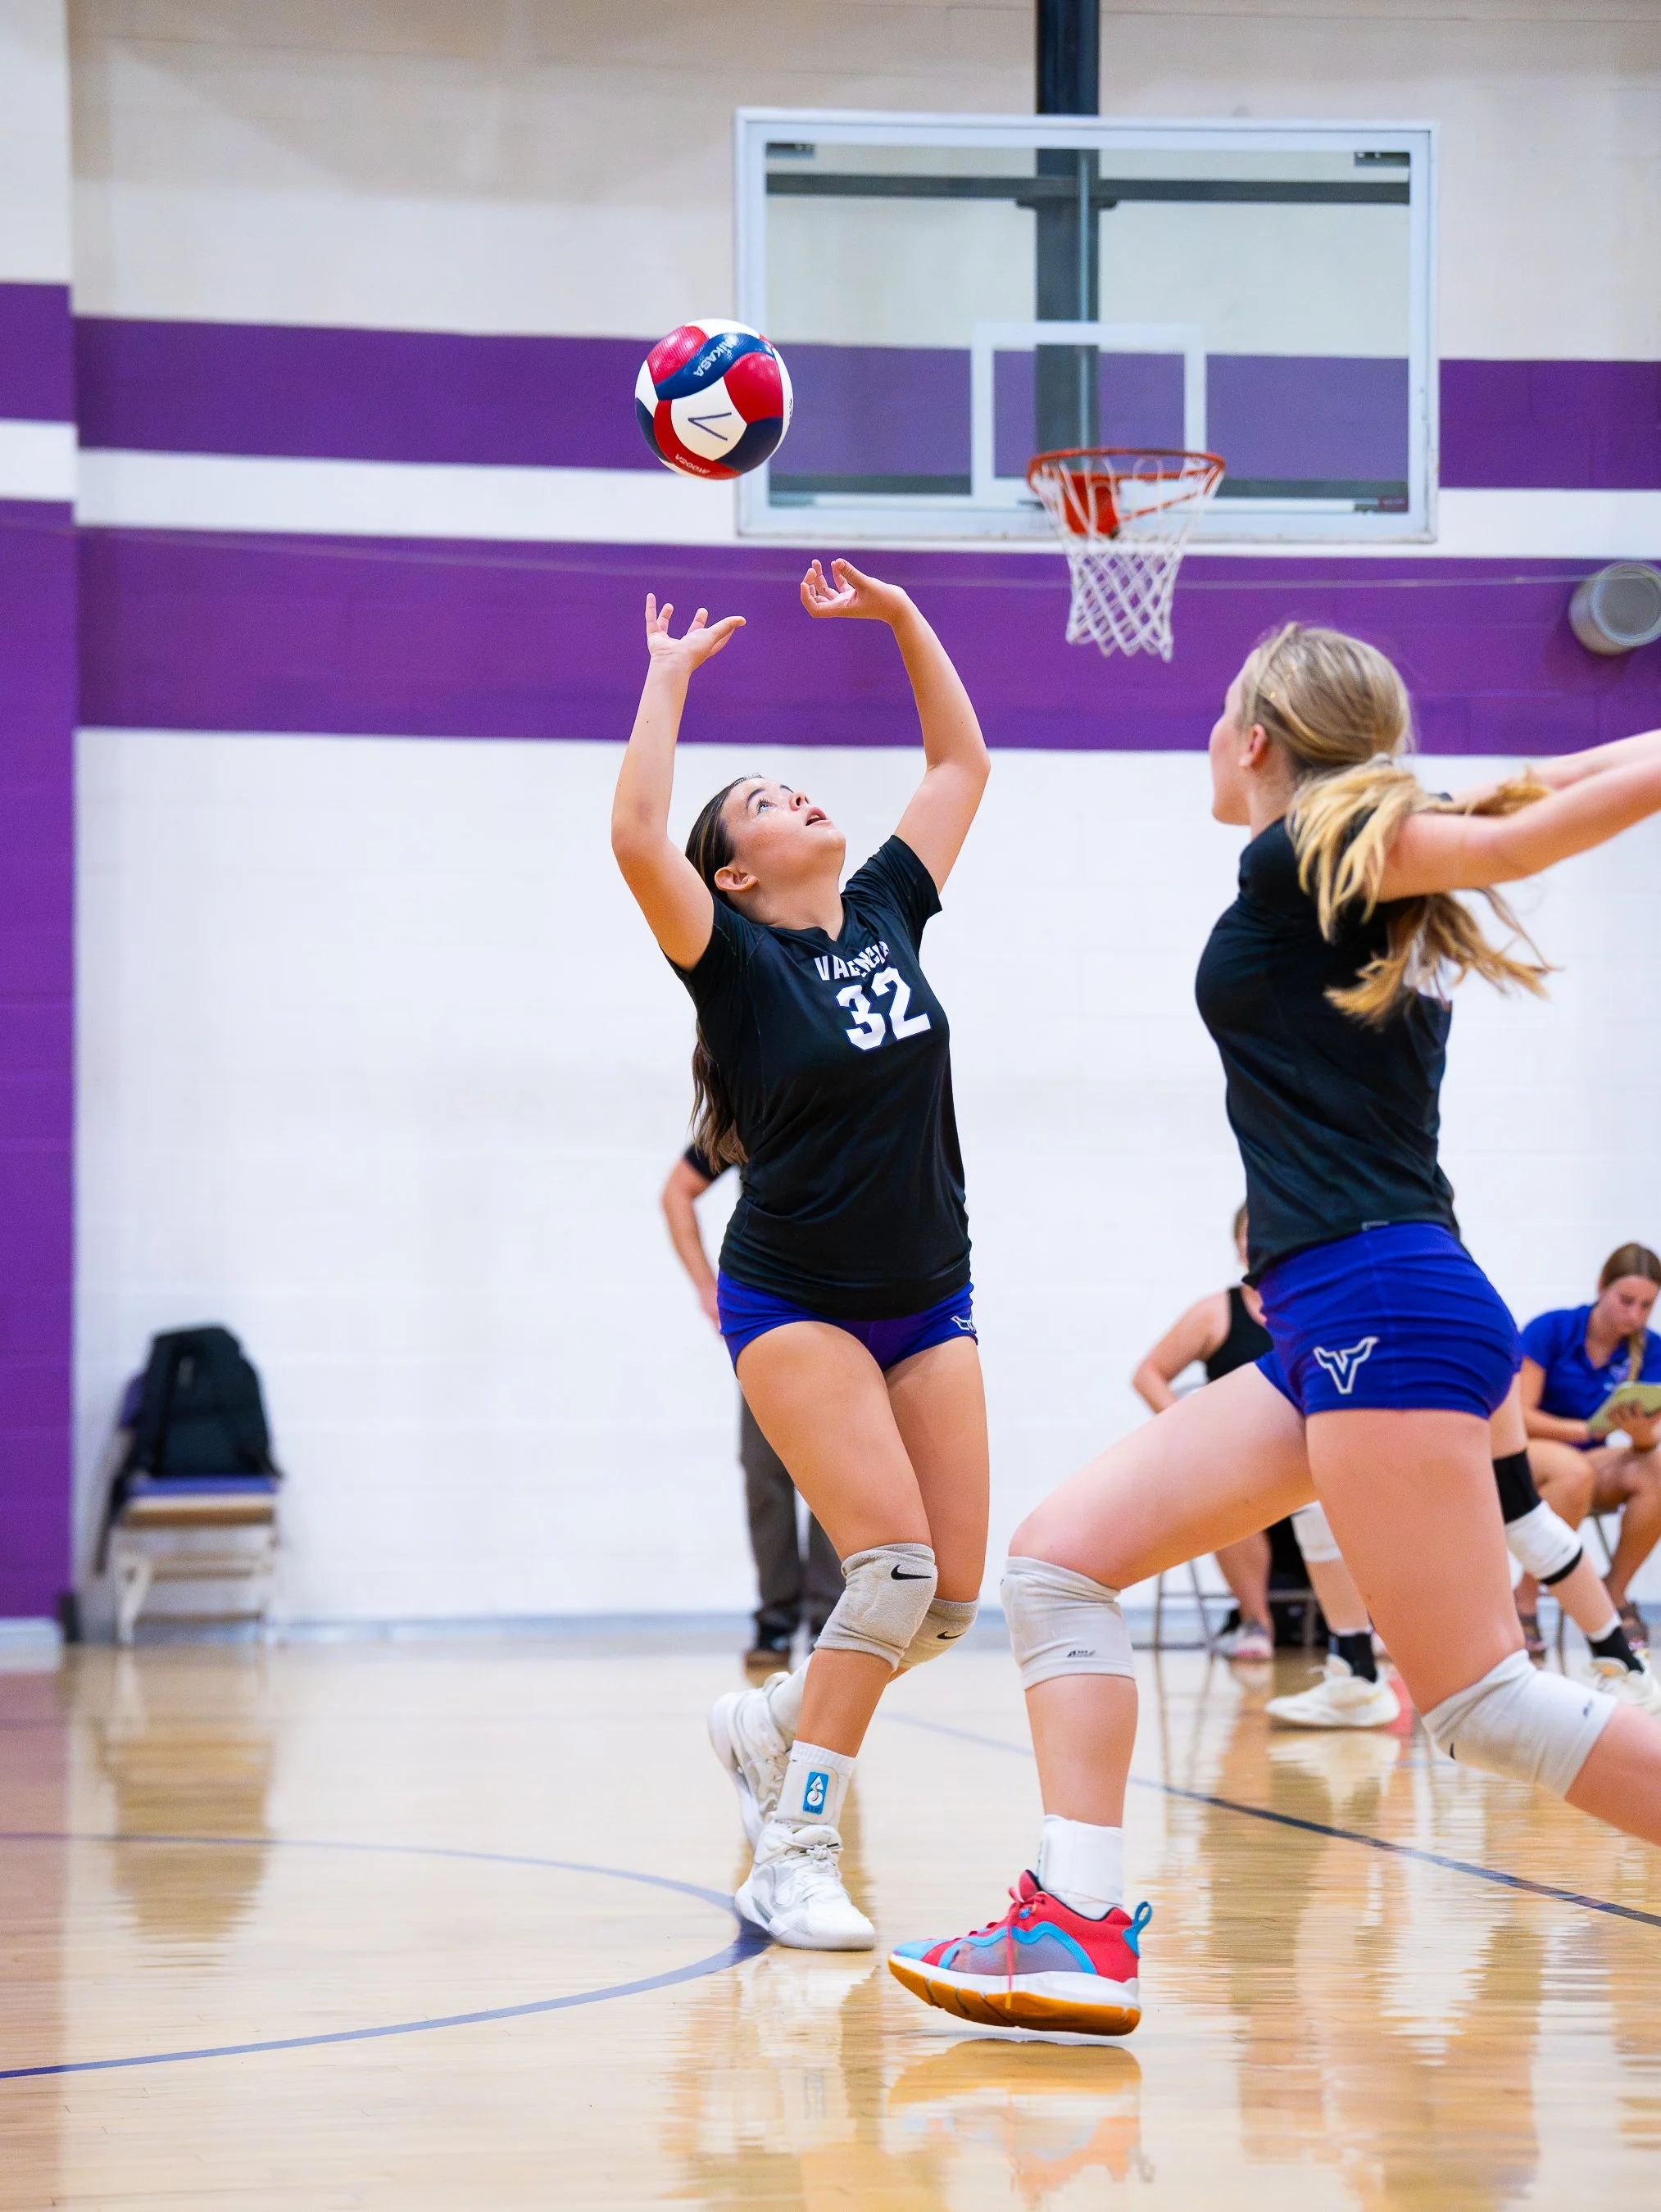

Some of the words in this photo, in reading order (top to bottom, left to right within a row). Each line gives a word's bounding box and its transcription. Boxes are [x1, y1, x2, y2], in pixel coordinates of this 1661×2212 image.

[693, 333, 737, 378] MIKASA
[814, 941, 889, 981] VAENCIA
[835, 965, 933, 1052] 32
